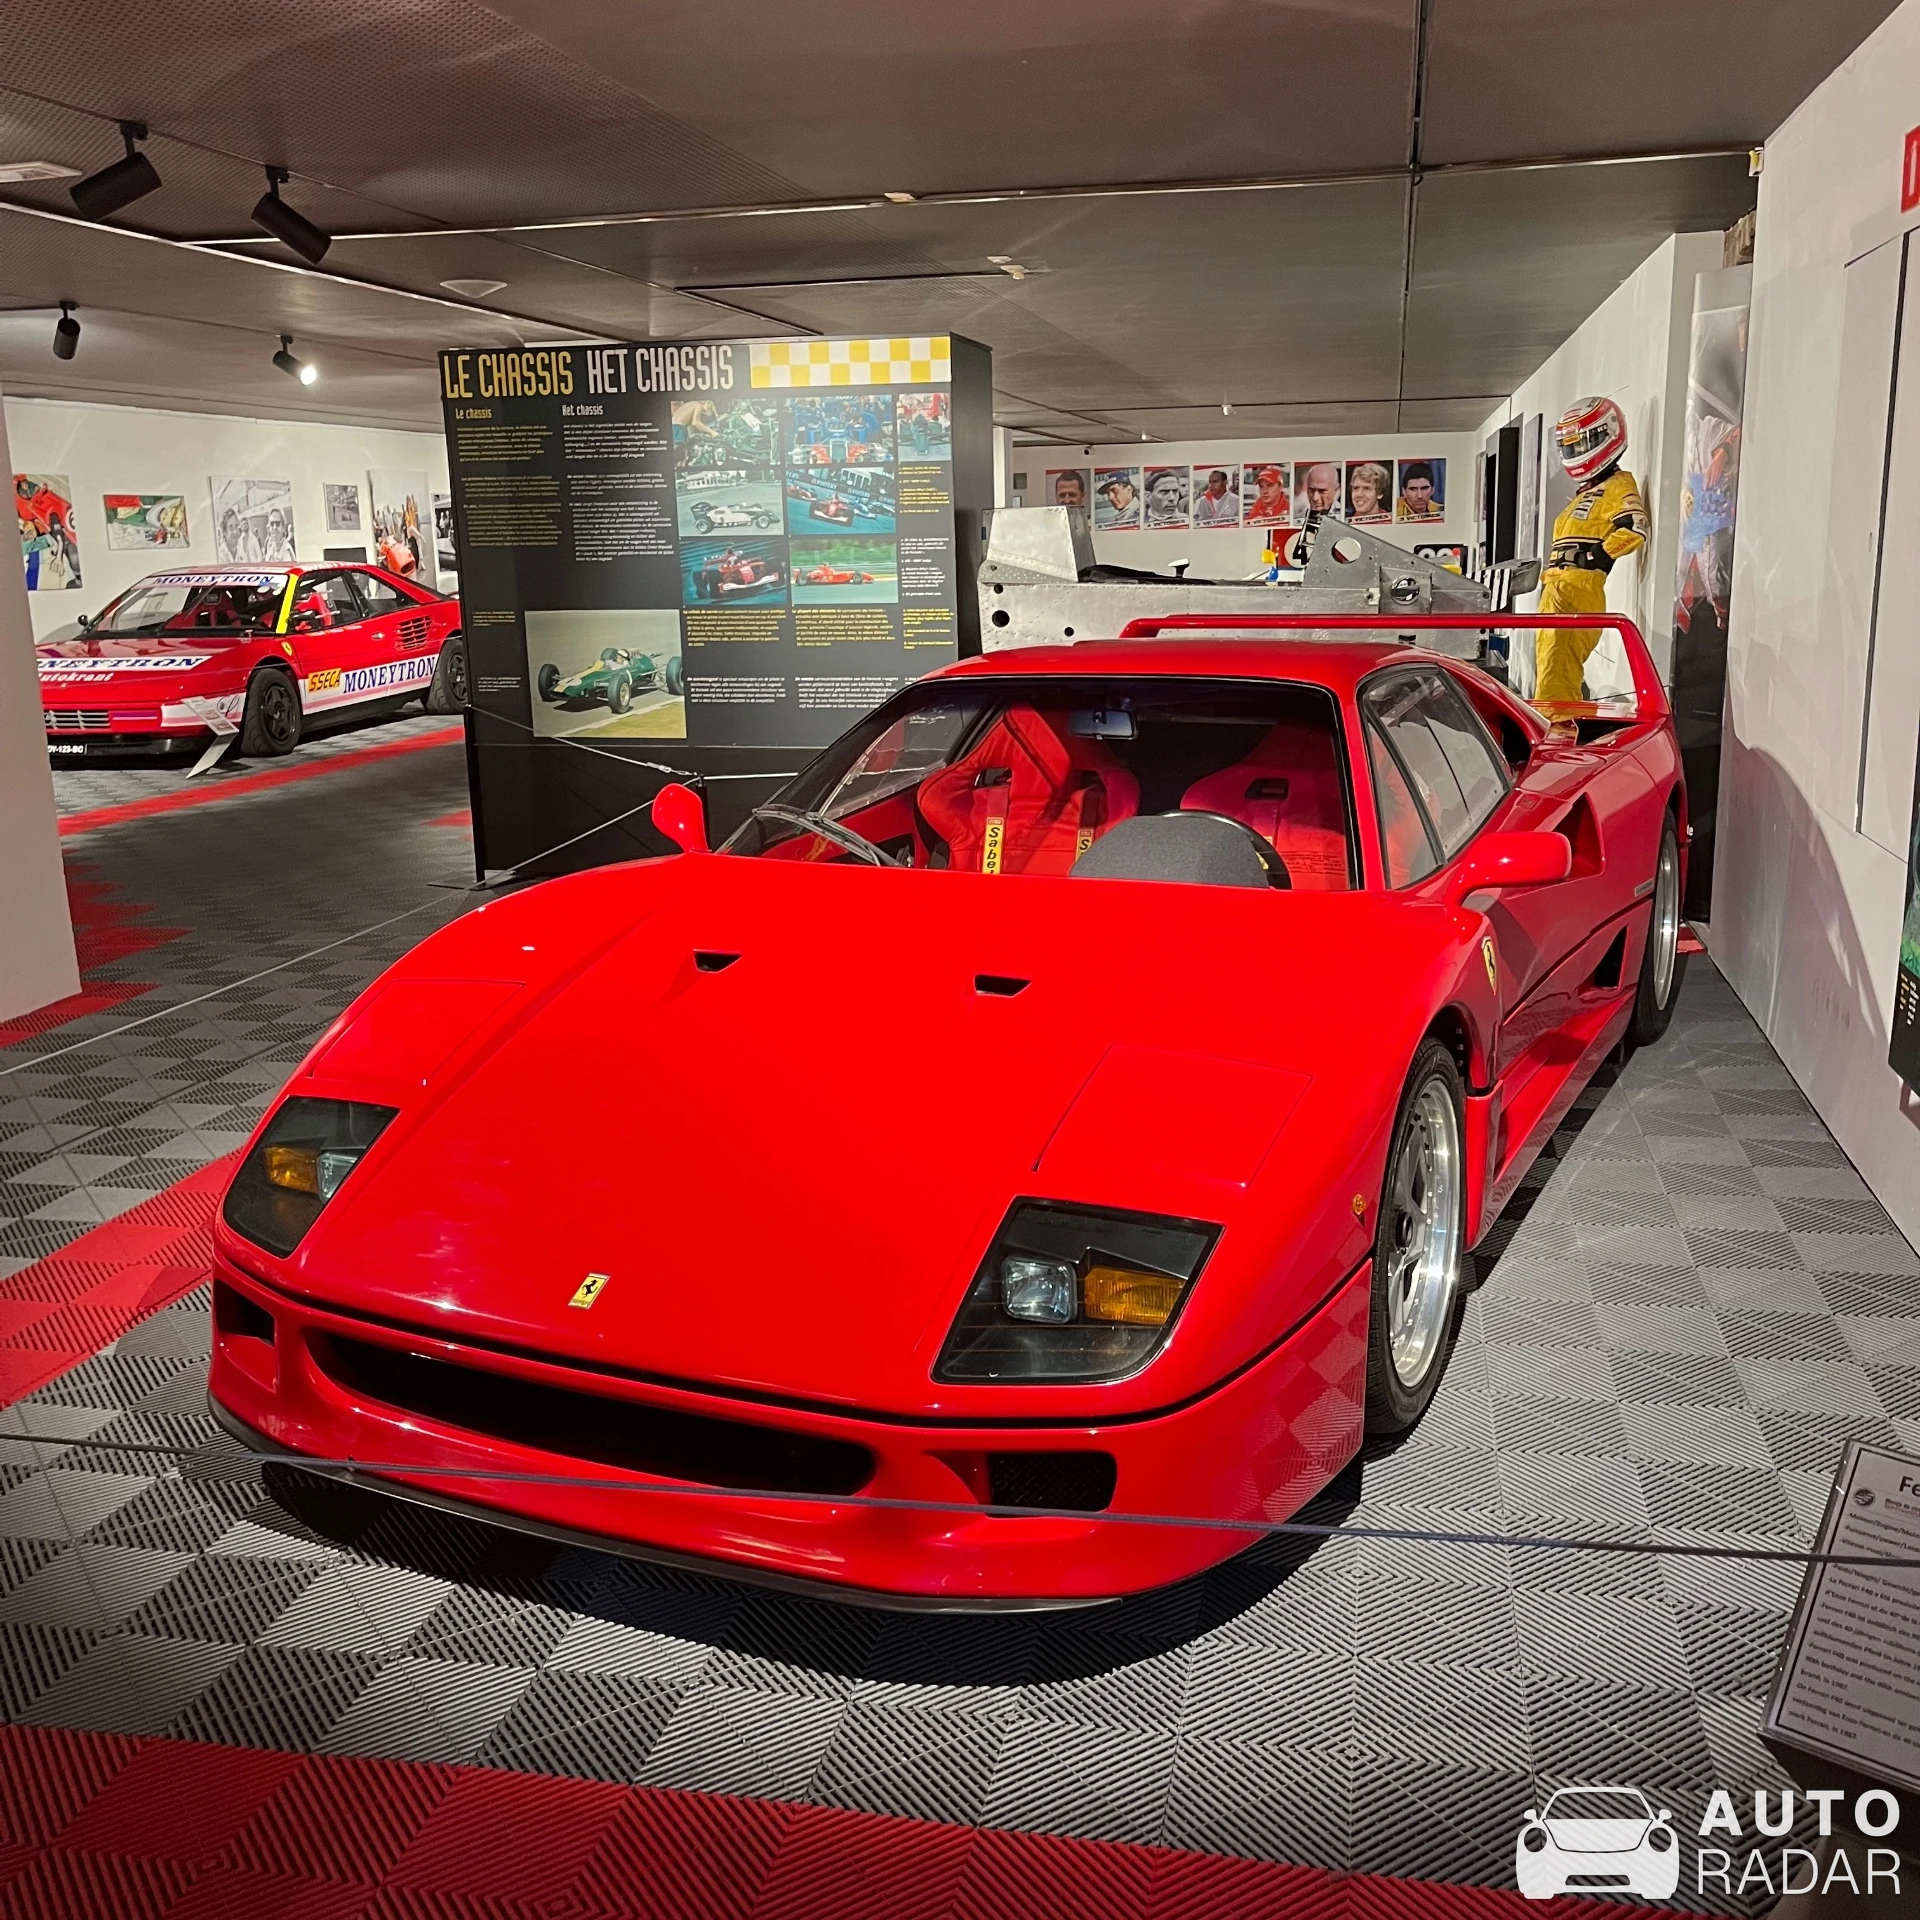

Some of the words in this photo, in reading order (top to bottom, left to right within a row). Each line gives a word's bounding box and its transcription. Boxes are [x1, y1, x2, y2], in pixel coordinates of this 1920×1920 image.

[444, 354, 473, 400] LE
[478, 351, 574, 398] CHASSIS
[586, 348, 629, 394] HET
[635, 344, 734, 393] CHASSIS
[455, 408, 465, 420] Le
[466, 407, 493, 419] chassis
[562, 404, 577, 416] Het
[578, 402, 604, 416] chassis
[153, 575, 276, 585] MONEYTRON
[343, 657, 436, 694] MONEYTRON
[1838, 1580, 1860, 1590] Ferrari
